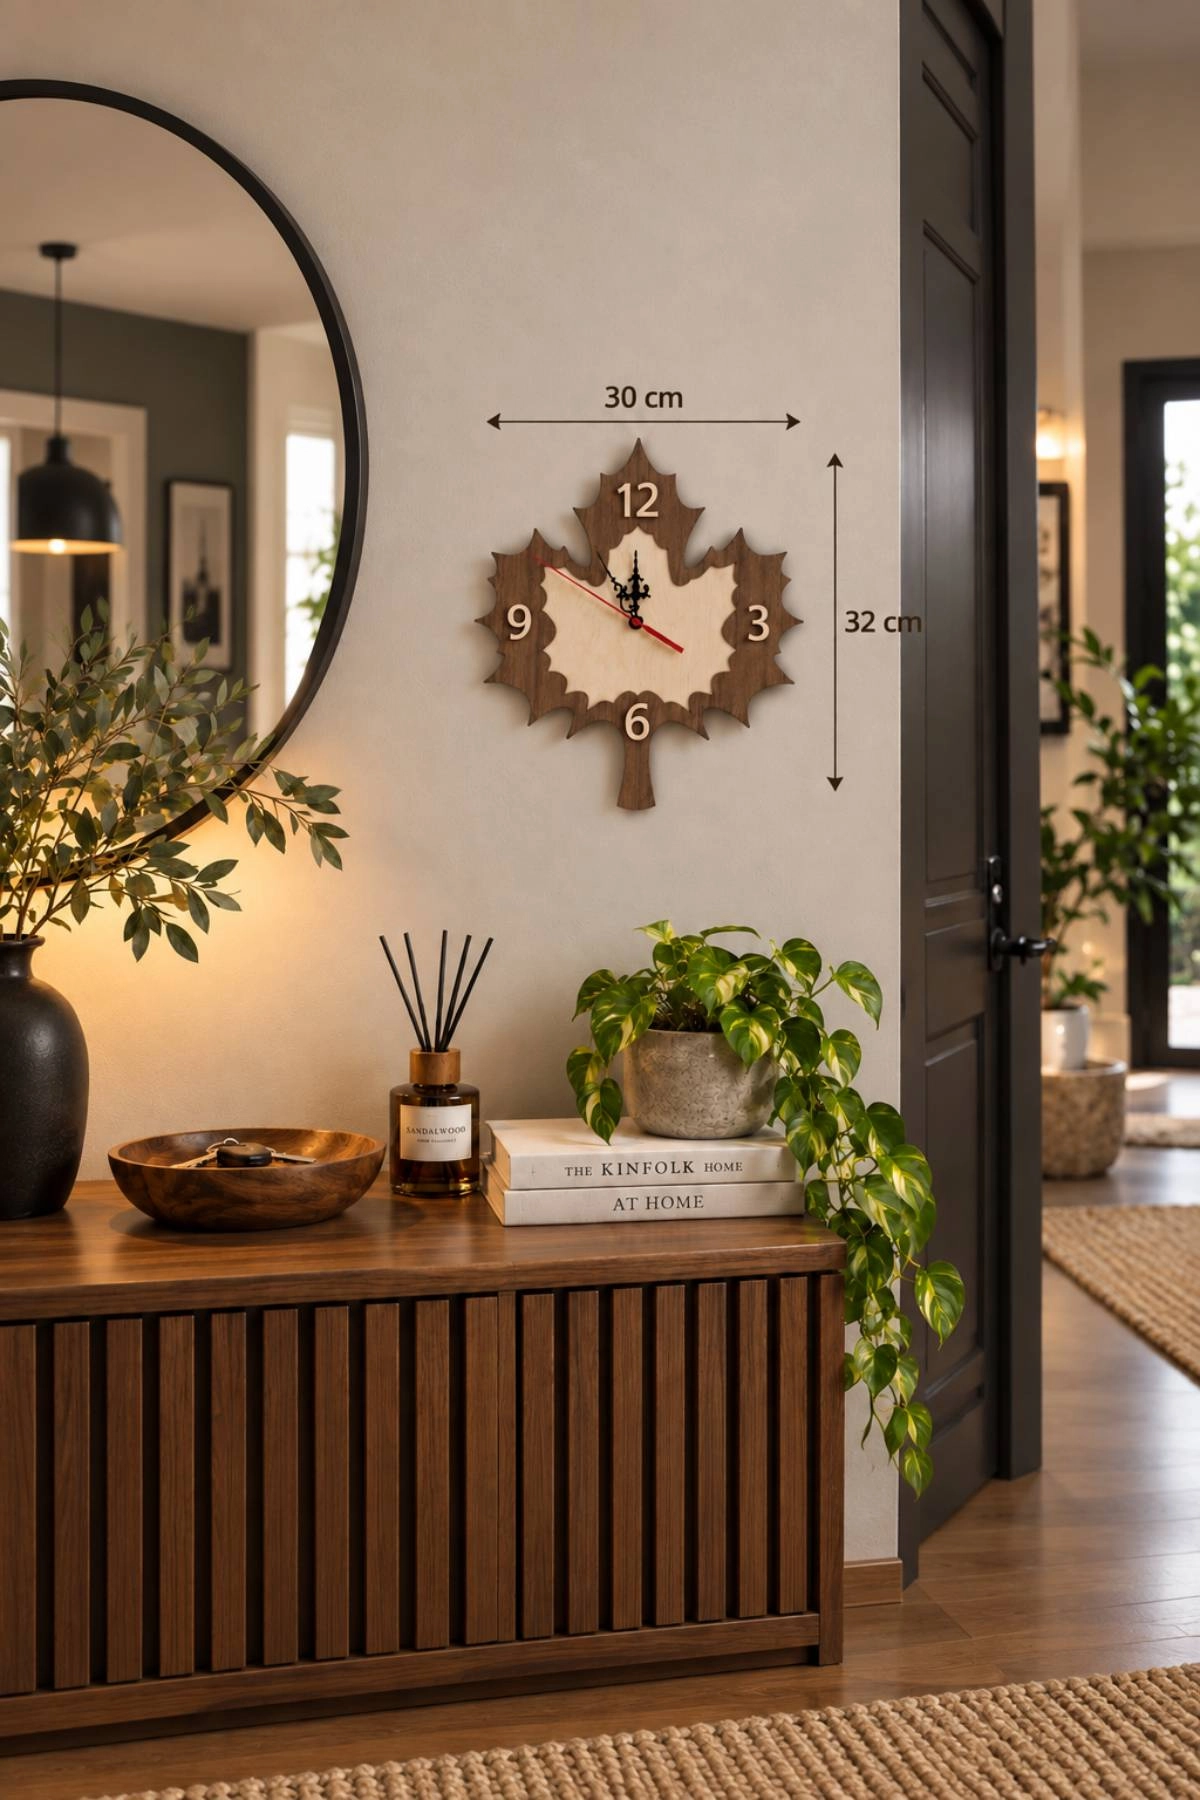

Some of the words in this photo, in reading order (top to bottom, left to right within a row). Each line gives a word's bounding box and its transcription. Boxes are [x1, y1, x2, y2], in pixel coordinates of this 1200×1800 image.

[616, 481, 660, 518] 12
[506, 603, 533, 641] 9
[747, 604, 771, 641] 3
[624, 702, 650, 741] 6
[406, 1126, 466, 1136] SANDALWOOD
[564, 1166, 593, 1177] THE
[601, 1160, 695, 1177] KINFOLK
[704, 1161, 744, 1173] HOME
[613, 1197, 636, 1212] AT
[646, 1195, 705, 1211] HOME
